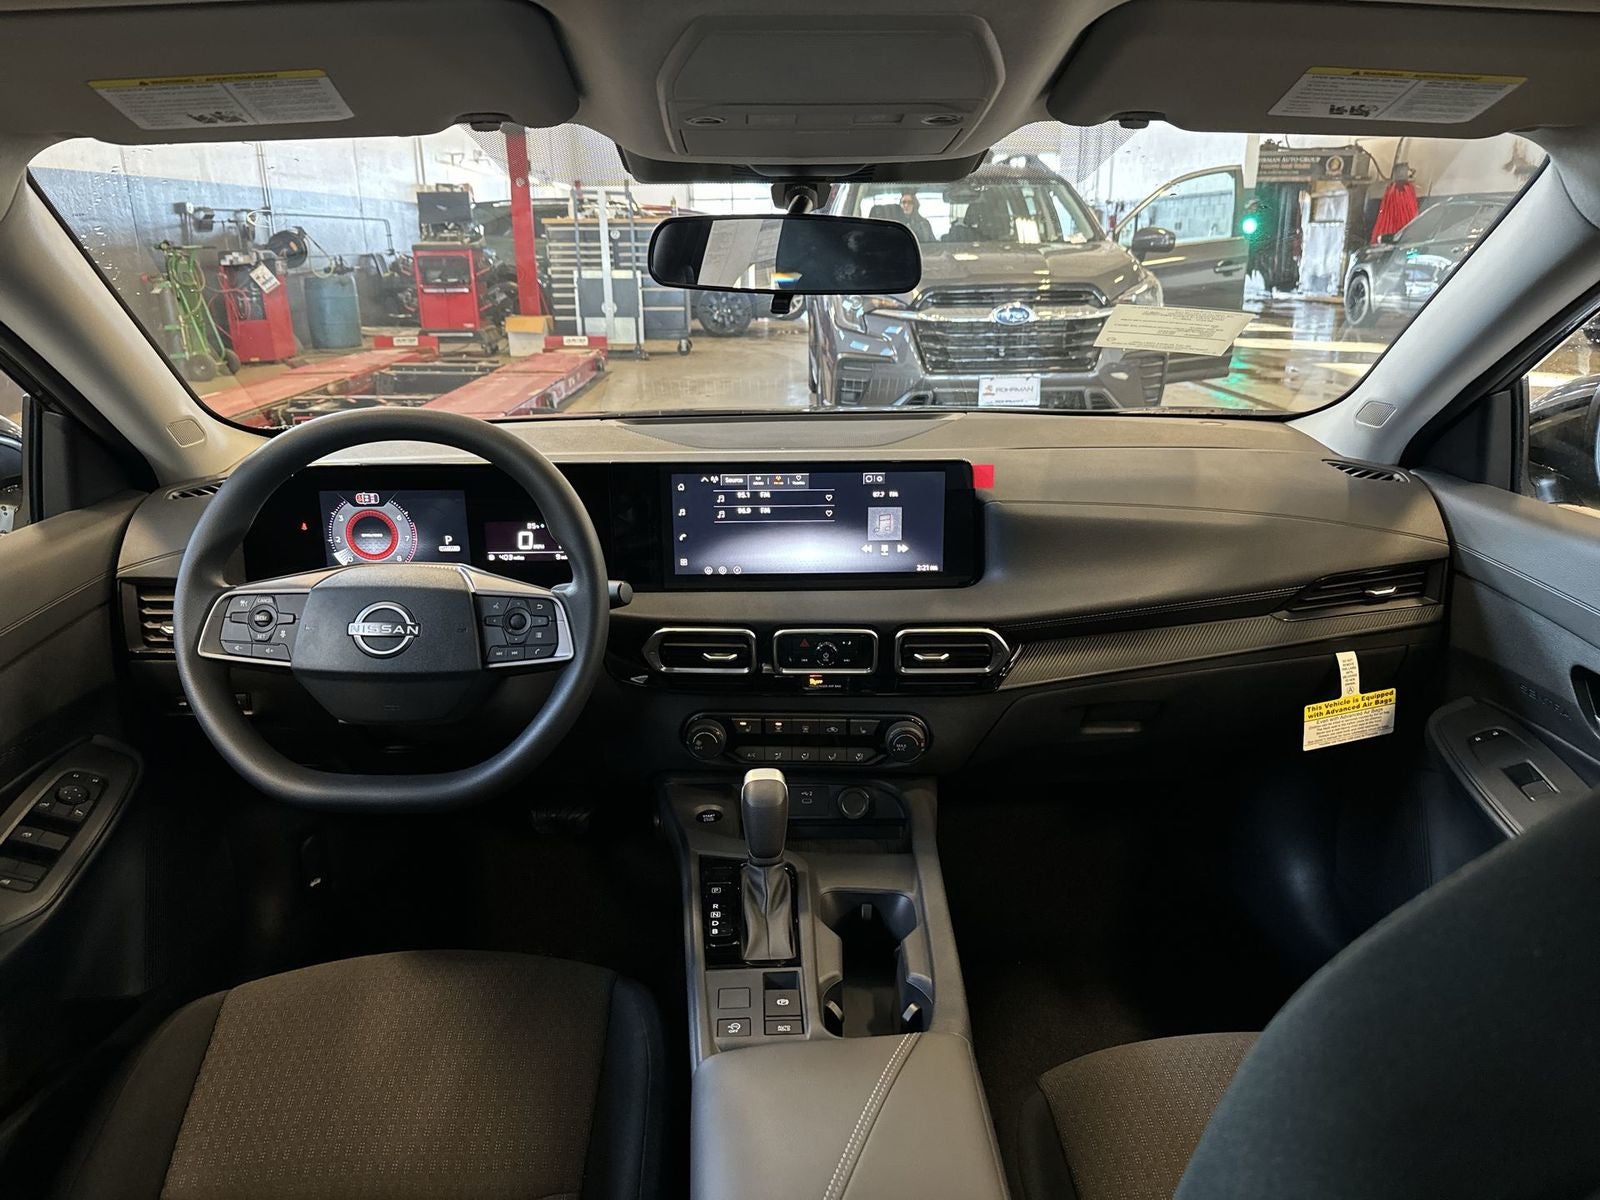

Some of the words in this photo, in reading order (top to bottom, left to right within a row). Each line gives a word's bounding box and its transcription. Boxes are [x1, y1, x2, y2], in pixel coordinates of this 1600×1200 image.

[444, 535, 453, 545] P
[517, 530, 534, 550] 0
[349, 624, 420, 635] NISSAN
[1307, 705, 1323, 713] This
[1324, 699, 1351, 709] Vehicle
[1361, 690, 1394, 702] Equipped
[1307, 710, 1324, 719] with
[1325, 704, 1361, 715] Advanced
[1362, 700, 1373, 708] Air
[1374, 698, 1393, 707] Bags
